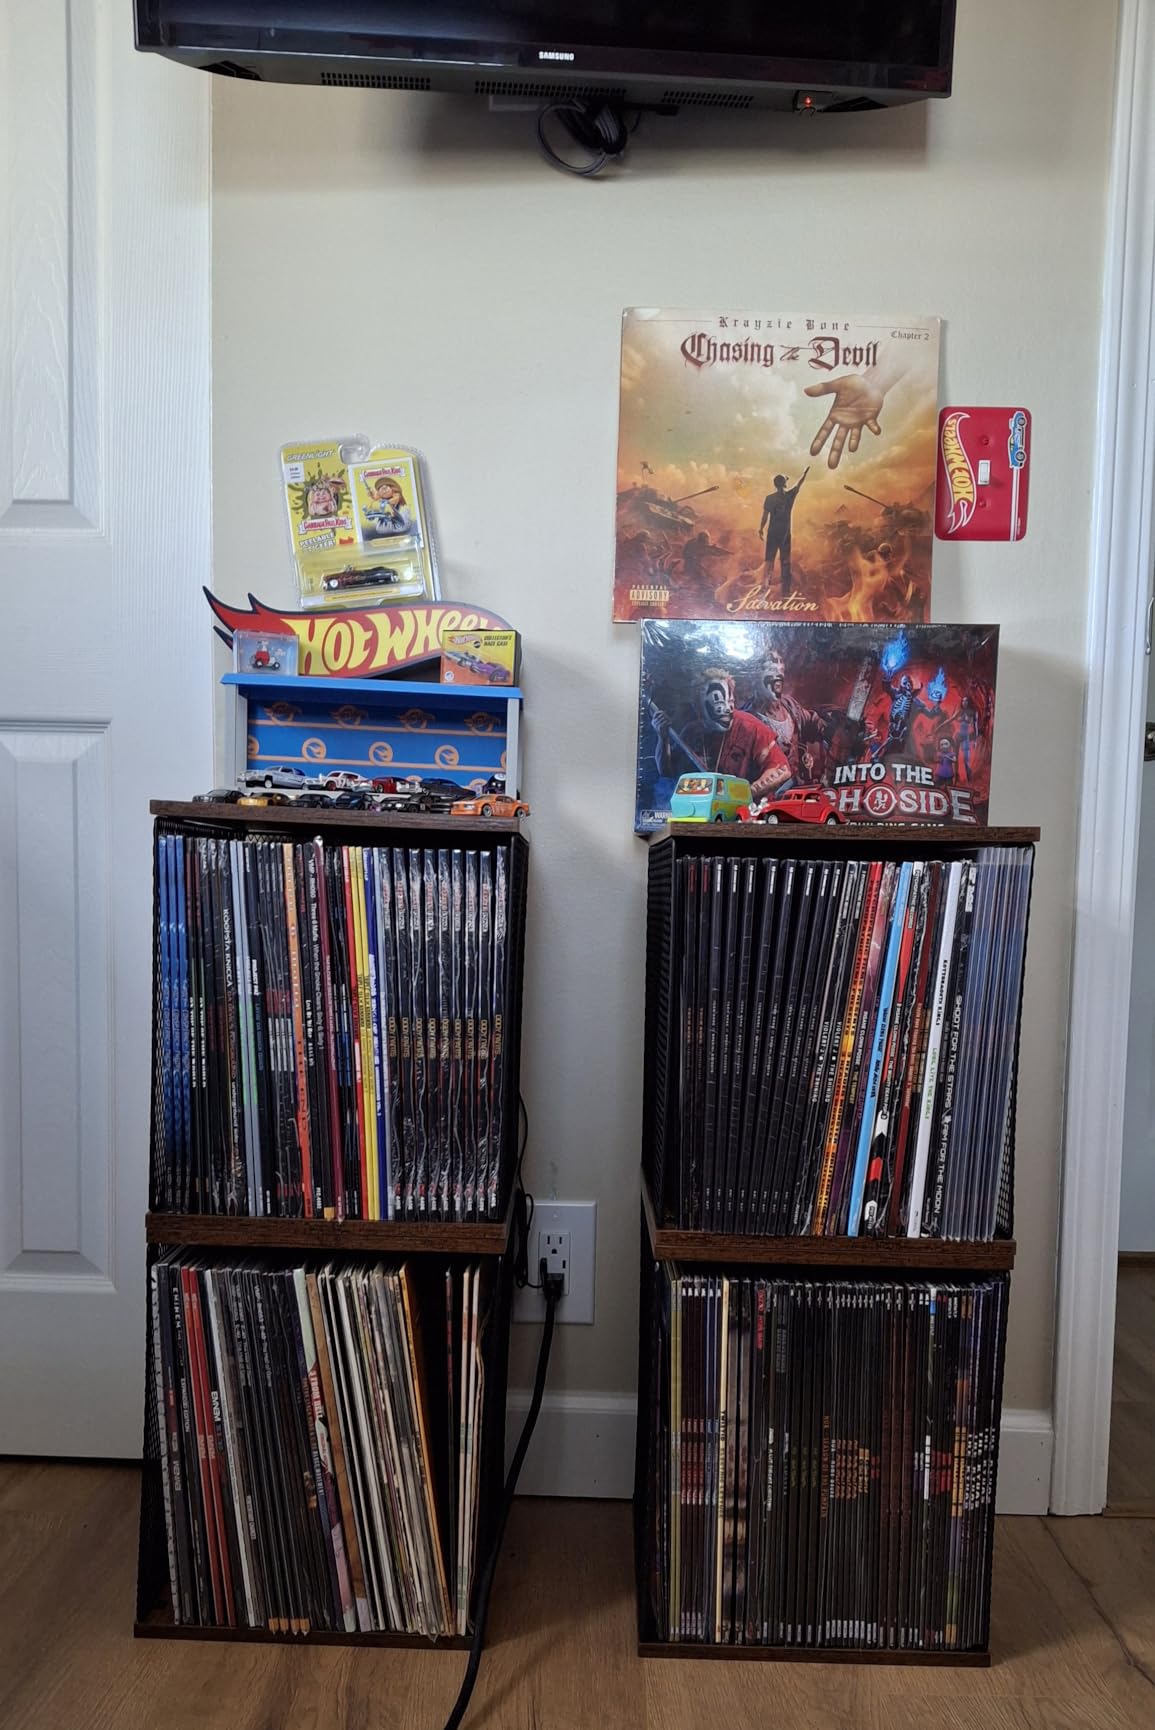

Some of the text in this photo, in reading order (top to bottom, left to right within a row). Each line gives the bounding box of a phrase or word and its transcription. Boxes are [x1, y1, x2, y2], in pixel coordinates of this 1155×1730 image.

[539, 51, 574, 60] SAMSUNG
[719, 316, 850, 331] Krayzie Bone
[891, 330, 922, 340] Chapter
[680, 332, 775, 367] Chasing
[807, 336, 880, 371] Devil
[630, 590, 669, 600] ADVISORY
[726, 585, 819, 613] Salvation
[833, 763, 935, 786] INTO THE
[860, 1011, 868, 1029] INSANE
[952, 995, 962, 1029] SHOOT
[820, 1021, 830, 1046] VIOLENT
[833, 1021, 842, 1046] VIOLENT
[858, 1030, 866, 1048] CLOWN
[950, 1031, 959, 1051] FOR
[855, 1049, 863, 1065] POSSE
[948, 1053, 957, 1073] THE
[828, 1064, 836, 1077] THE
[812, 1078, 821, 1102] SHINING
[824, 1078, 834, 1102] SHINING
[944, 1075, 955, 1108] STARS
[940, 1124, 949, 1140] AIM
[938, 1142, 948, 1161] FOR
[936, 1164, 945, 1182] THE
[933, 1184, 943, 1213] MOON
[172, 1287, 182, 1329] EMINEM
[183, 1410, 191, 1432] EDITION
[310, 1378, 320, 1400] FROM
